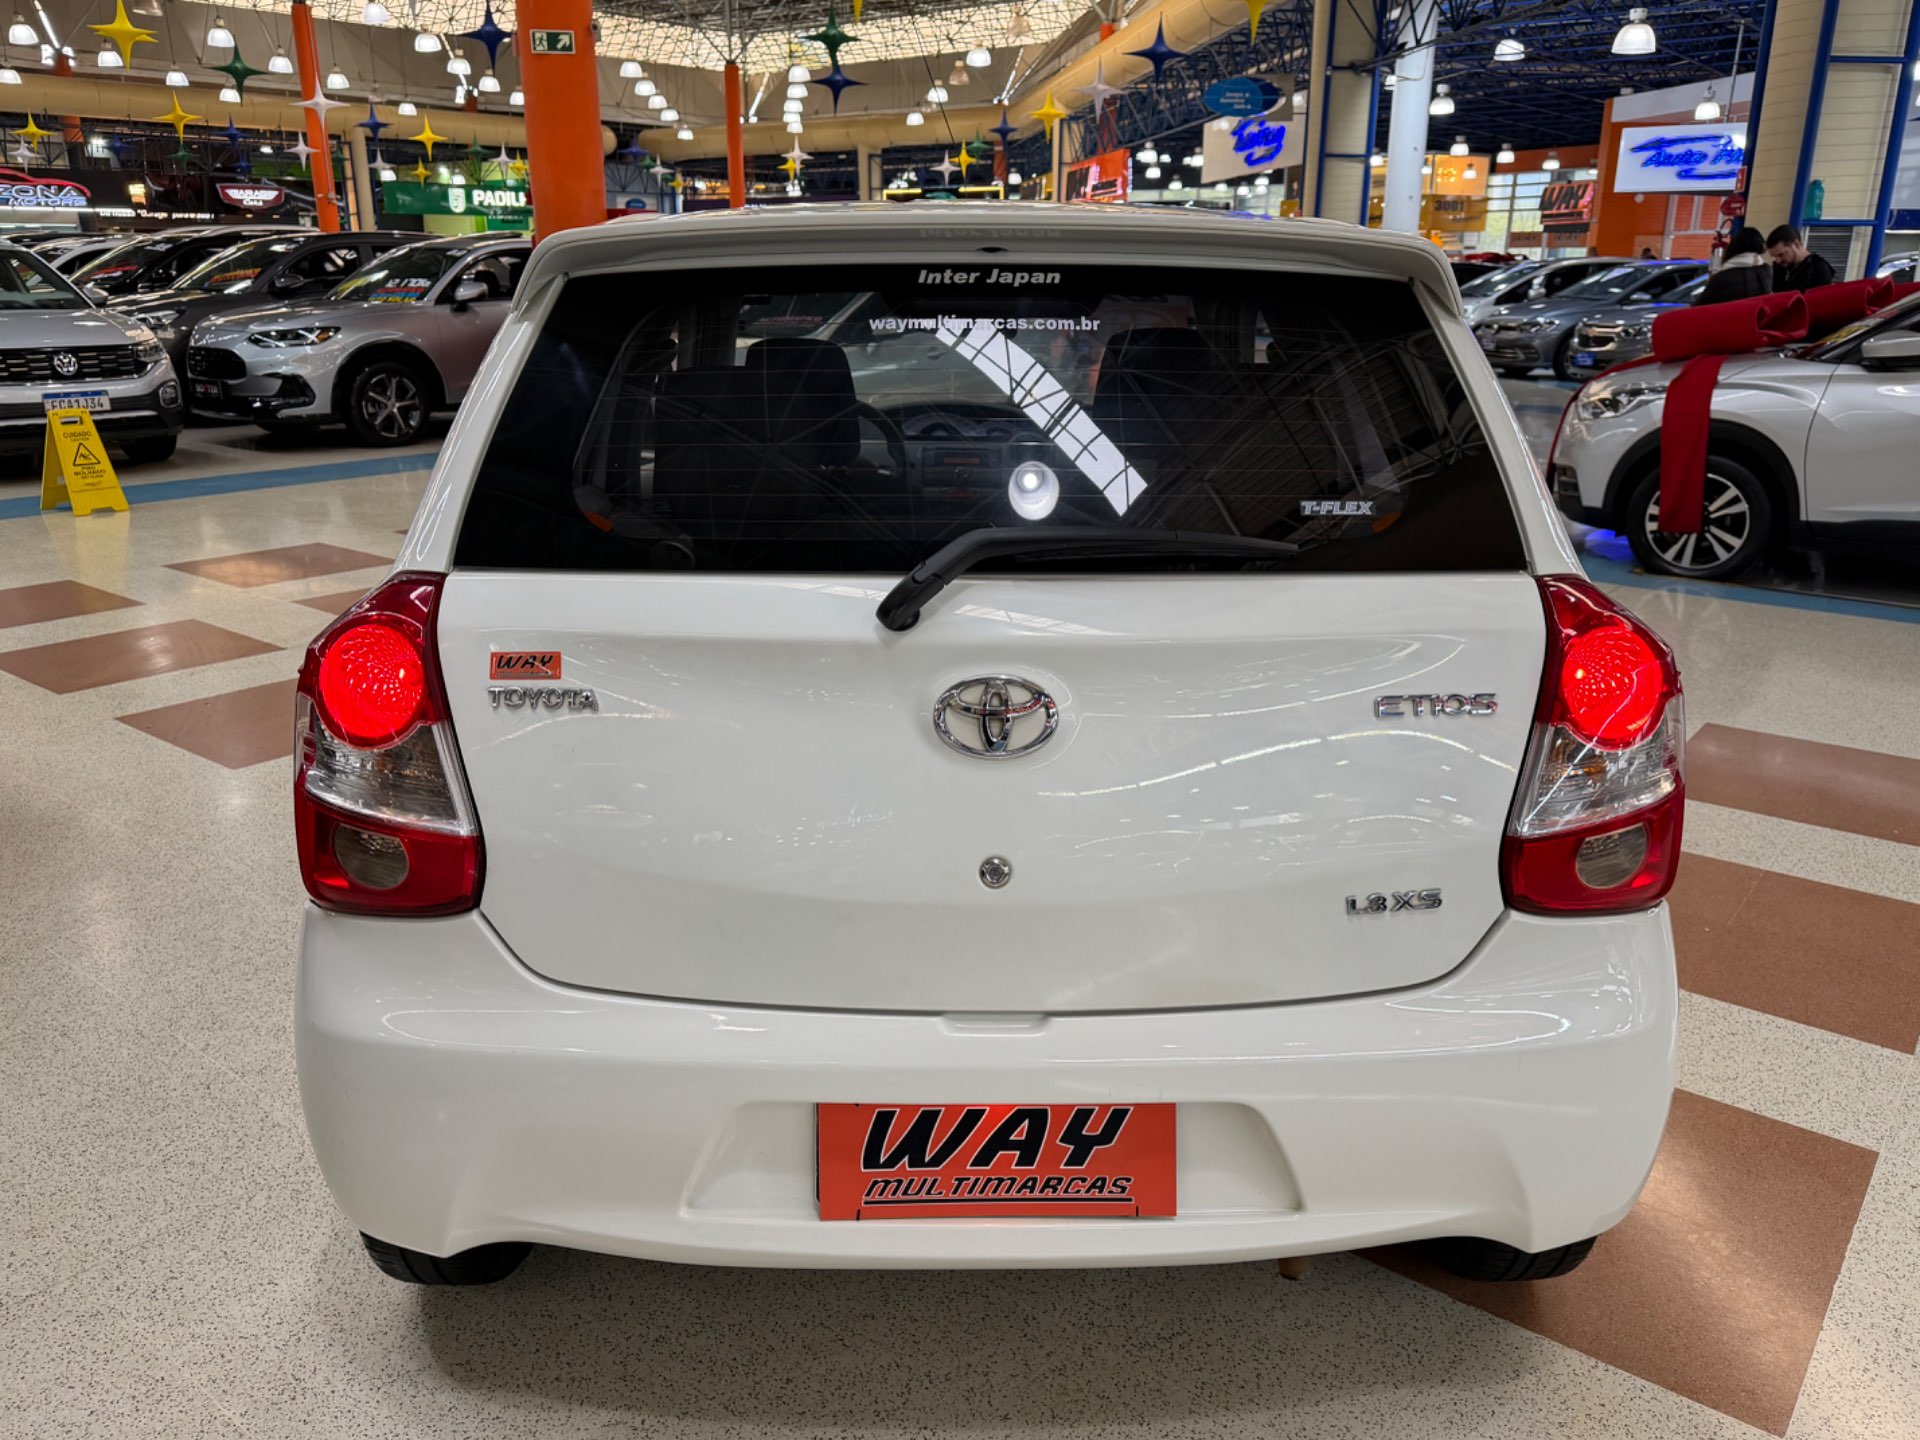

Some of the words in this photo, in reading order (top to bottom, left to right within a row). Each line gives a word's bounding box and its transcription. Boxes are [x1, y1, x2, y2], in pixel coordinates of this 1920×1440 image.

[8, 197, 87, 206] MOTORS
[1540, 183, 1590, 210] WAY
[917, 268, 981, 285] Inter
[985, 268, 1062, 288] Japan
[868, 313, 1101, 333] waymultimarcas.com.br
[62, 430, 92, 439] CUIDADO
[1301, 500, 1374, 516] T-FLEX
[496, 655, 554, 669] WAY
[487, 686, 600, 713] TOYOTA
[1373, 693, 1499, 718] ETIOS
[860, 1105, 1134, 1172] WAY
[863, 1175, 1134, 1198] MULTIMARCAS
